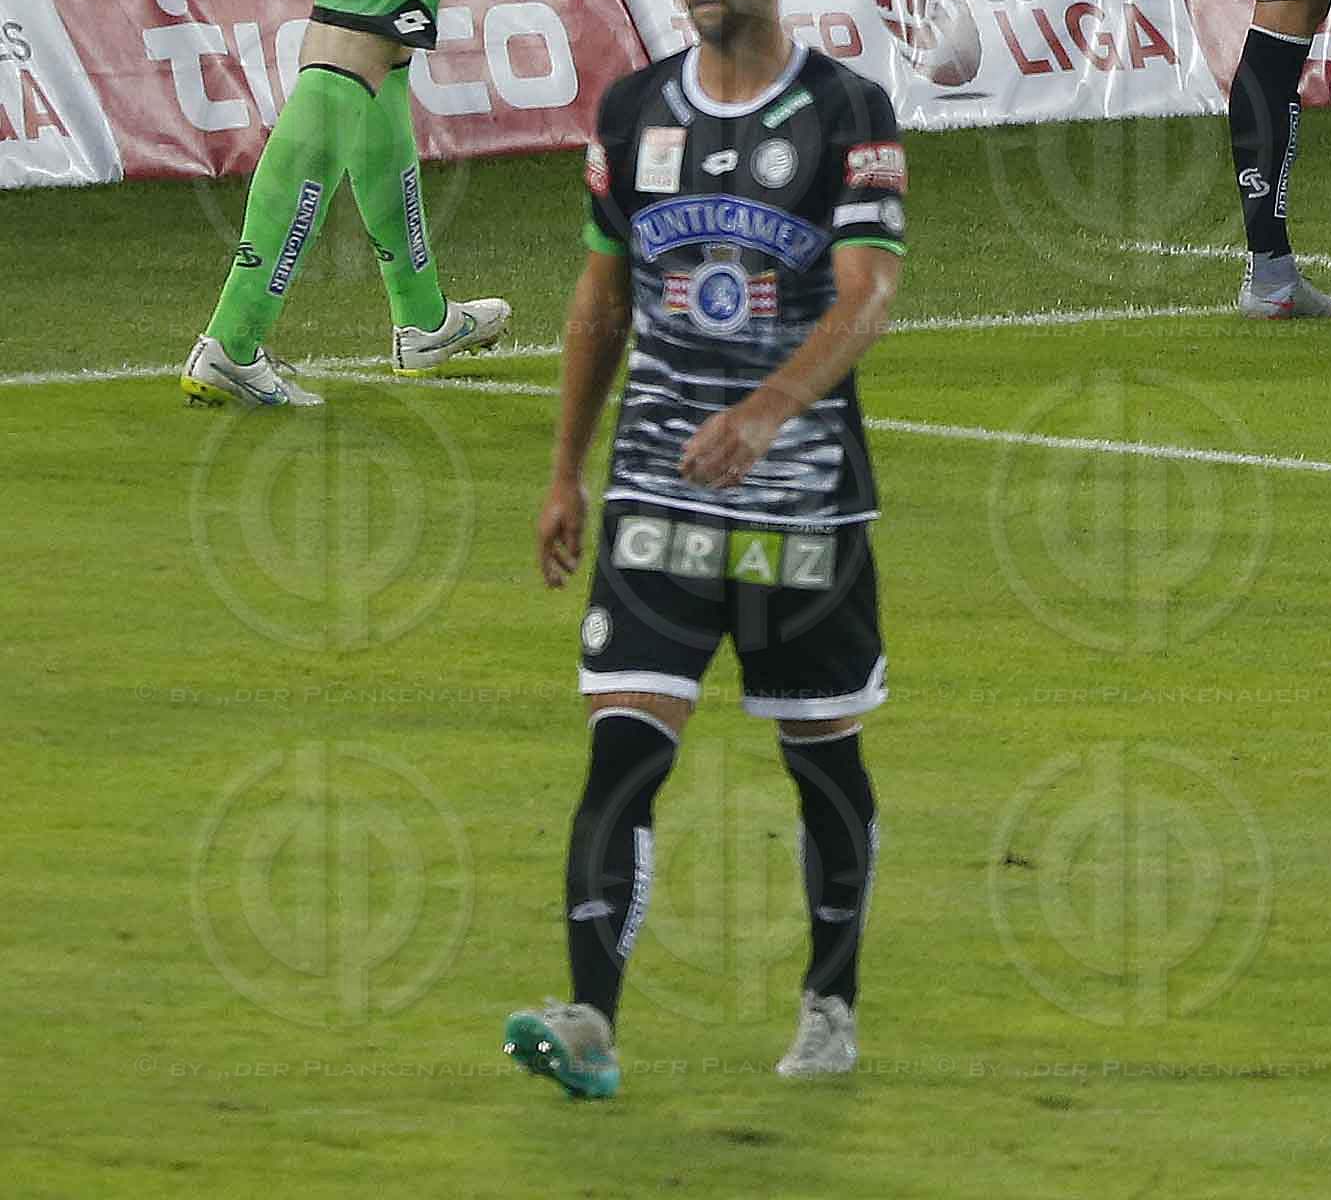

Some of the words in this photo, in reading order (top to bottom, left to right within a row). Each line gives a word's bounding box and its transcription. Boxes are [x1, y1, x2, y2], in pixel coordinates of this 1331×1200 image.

[992, 3, 1178, 77] LIGA
[271, 183, 319, 294] PUNTIGAMER
[402, 167, 425, 270] PUNTIGAMER
[635, 202, 808, 260] PUNTIGAMER
[618, 522, 829, 584] GRAZ
